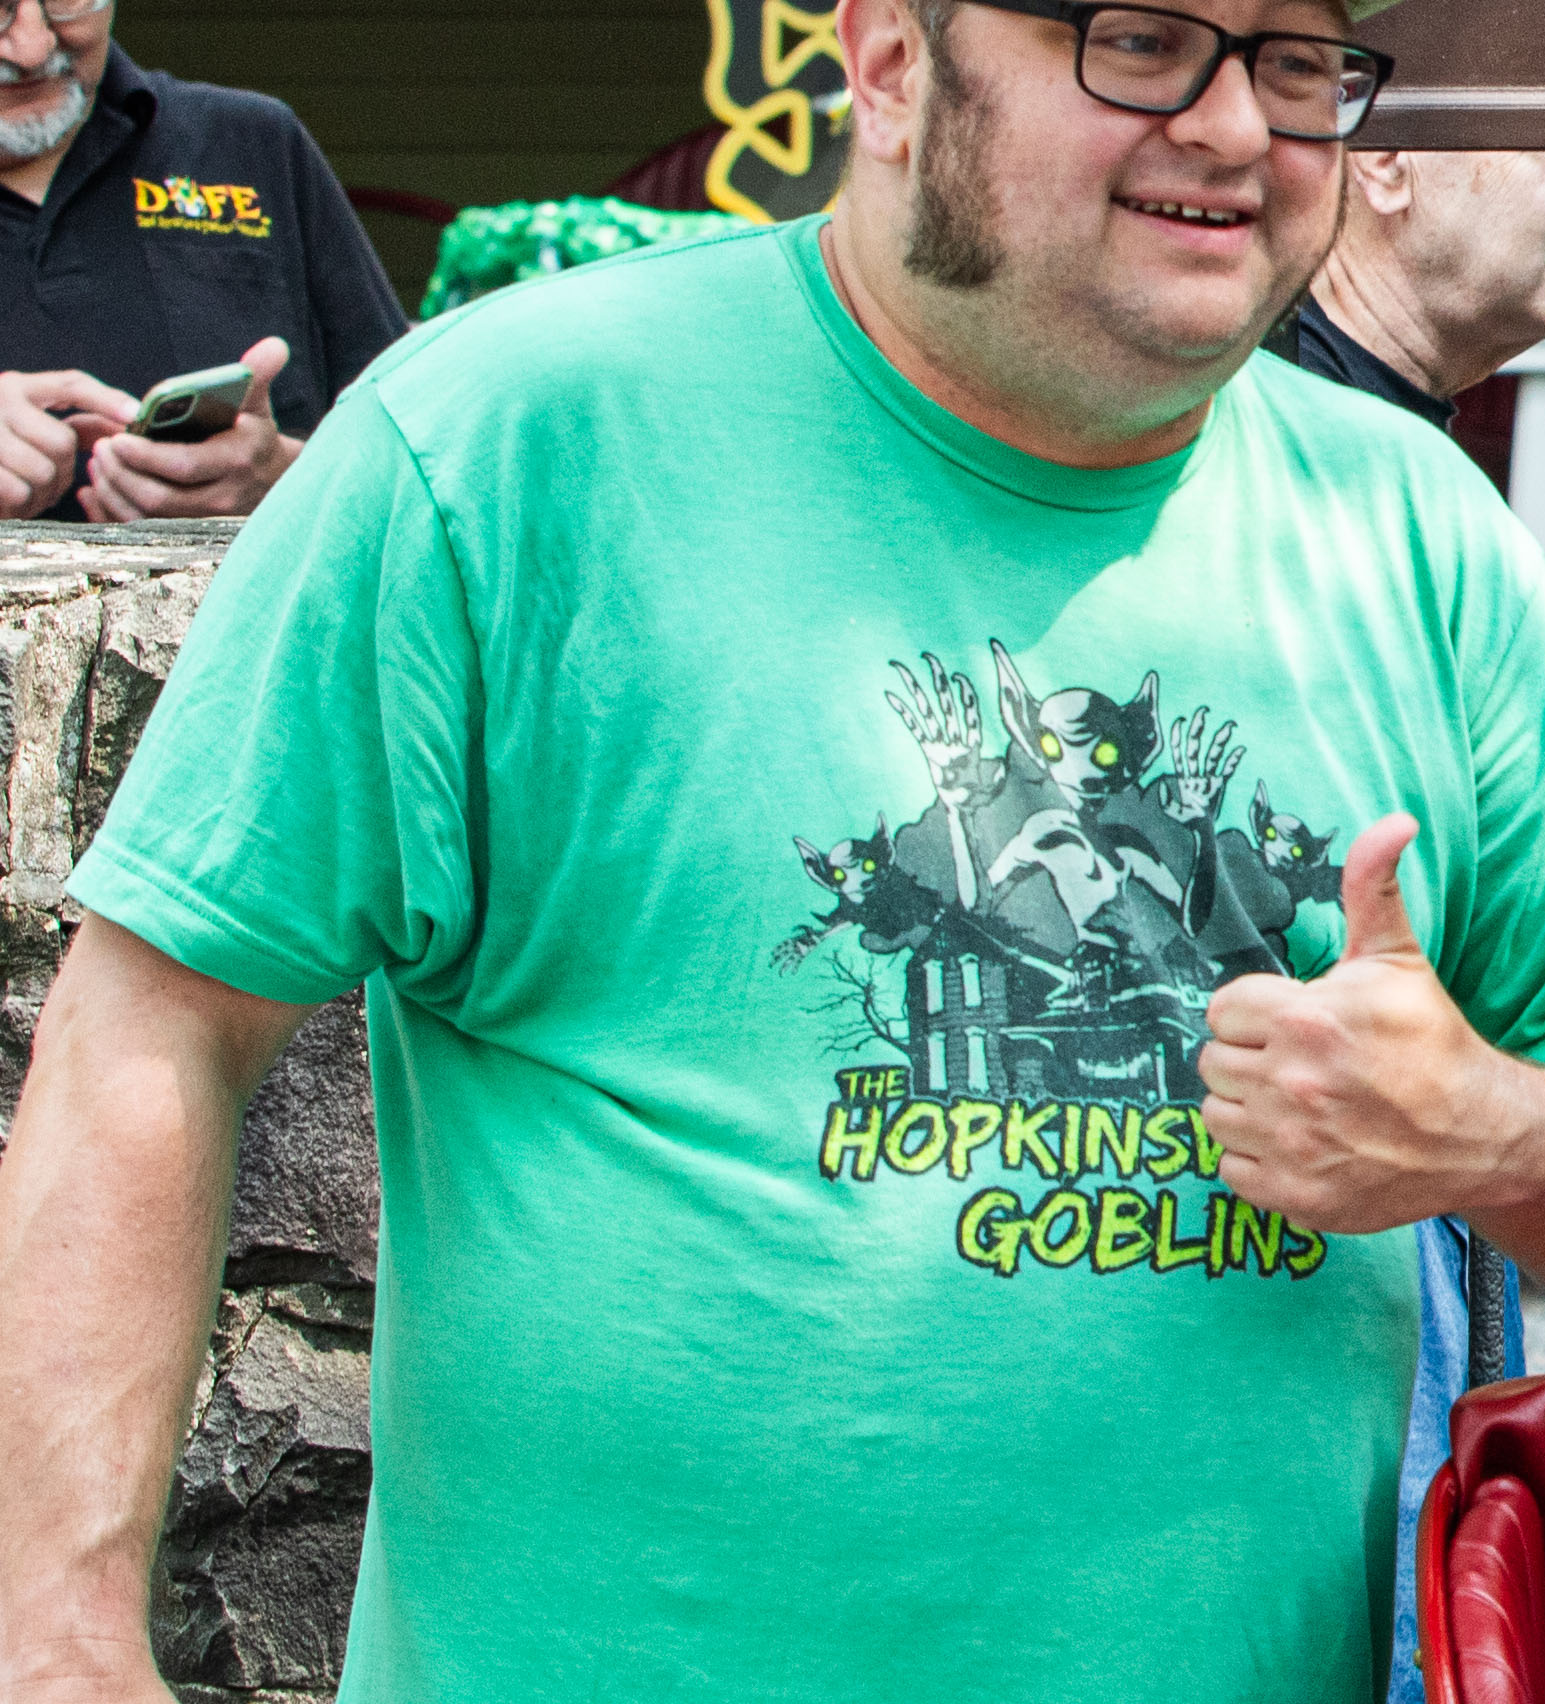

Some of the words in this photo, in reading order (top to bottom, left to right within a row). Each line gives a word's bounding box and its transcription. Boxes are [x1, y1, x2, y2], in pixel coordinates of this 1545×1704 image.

[838, 1066, 907, 1099] THE
[819, 1099, 1224, 1182] HOPKINSV
[957, 1186, 1327, 1280] GOBLINS
